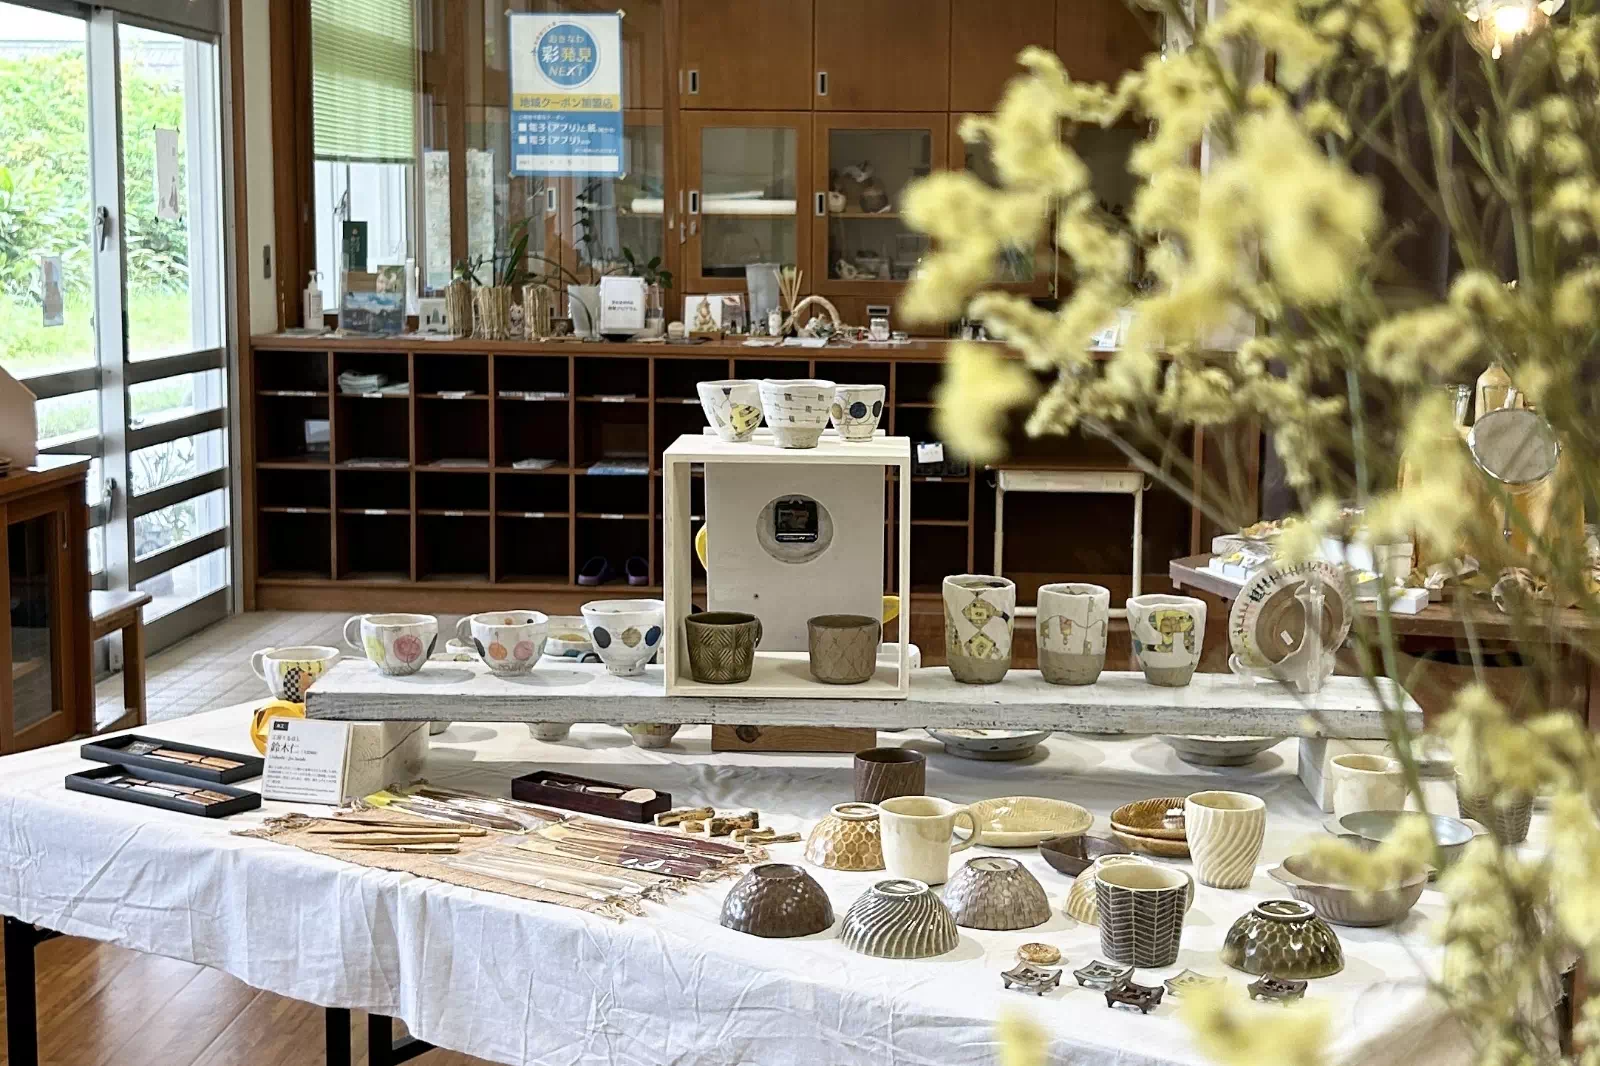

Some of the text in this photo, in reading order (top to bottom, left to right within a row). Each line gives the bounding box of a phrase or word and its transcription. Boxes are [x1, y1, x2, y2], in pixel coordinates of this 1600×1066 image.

[548, 34, 585, 44] おきなわ
[541, 45, 593, 63] 彩発見
[548, 64, 585, 77] NEXT
